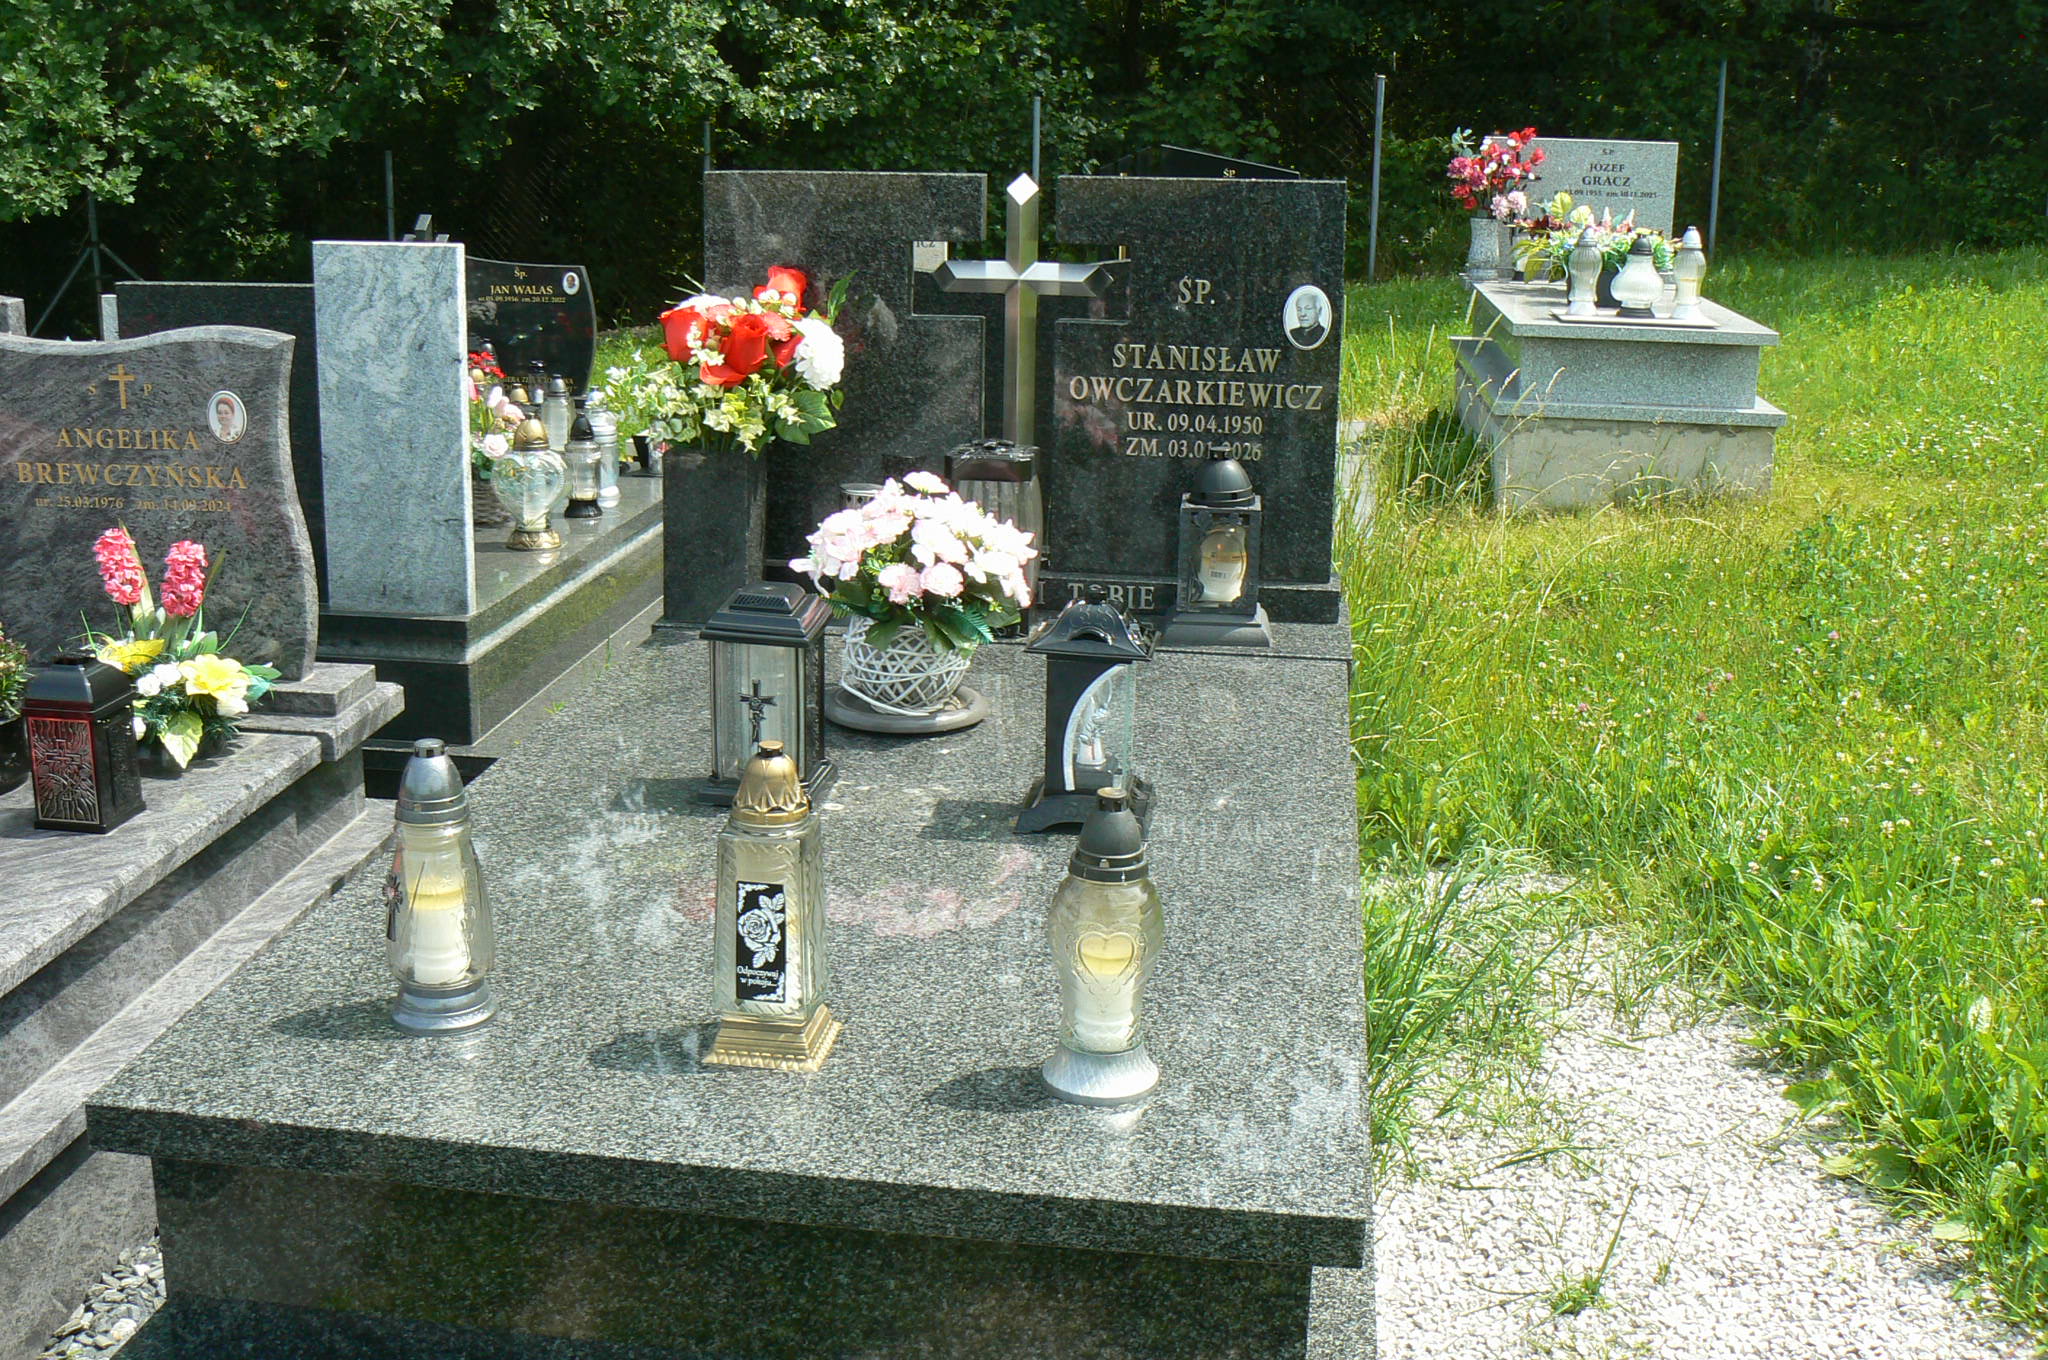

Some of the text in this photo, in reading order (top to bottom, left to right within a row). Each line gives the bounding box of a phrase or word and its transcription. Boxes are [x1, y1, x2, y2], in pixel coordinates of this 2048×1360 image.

[1582, 176, 1631, 186] GRACZ
[490, 285, 554, 295] JAN WALAS
[1177, 275, 1216, 306] ŚP.
[1111, 343, 1281, 374] STANISŁAW
[1069, 375, 1323, 411] OWCZARKIEWICZ
[1127, 412, 1263, 435] UR. 09.04.1950
[55, 427, 201, 451] ANGELIKA
[1125, 438, 1163, 458] ZM.
[15, 461, 248, 489] BREWCZYŃSKA
[1067, 583, 1155, 610] TBIE
